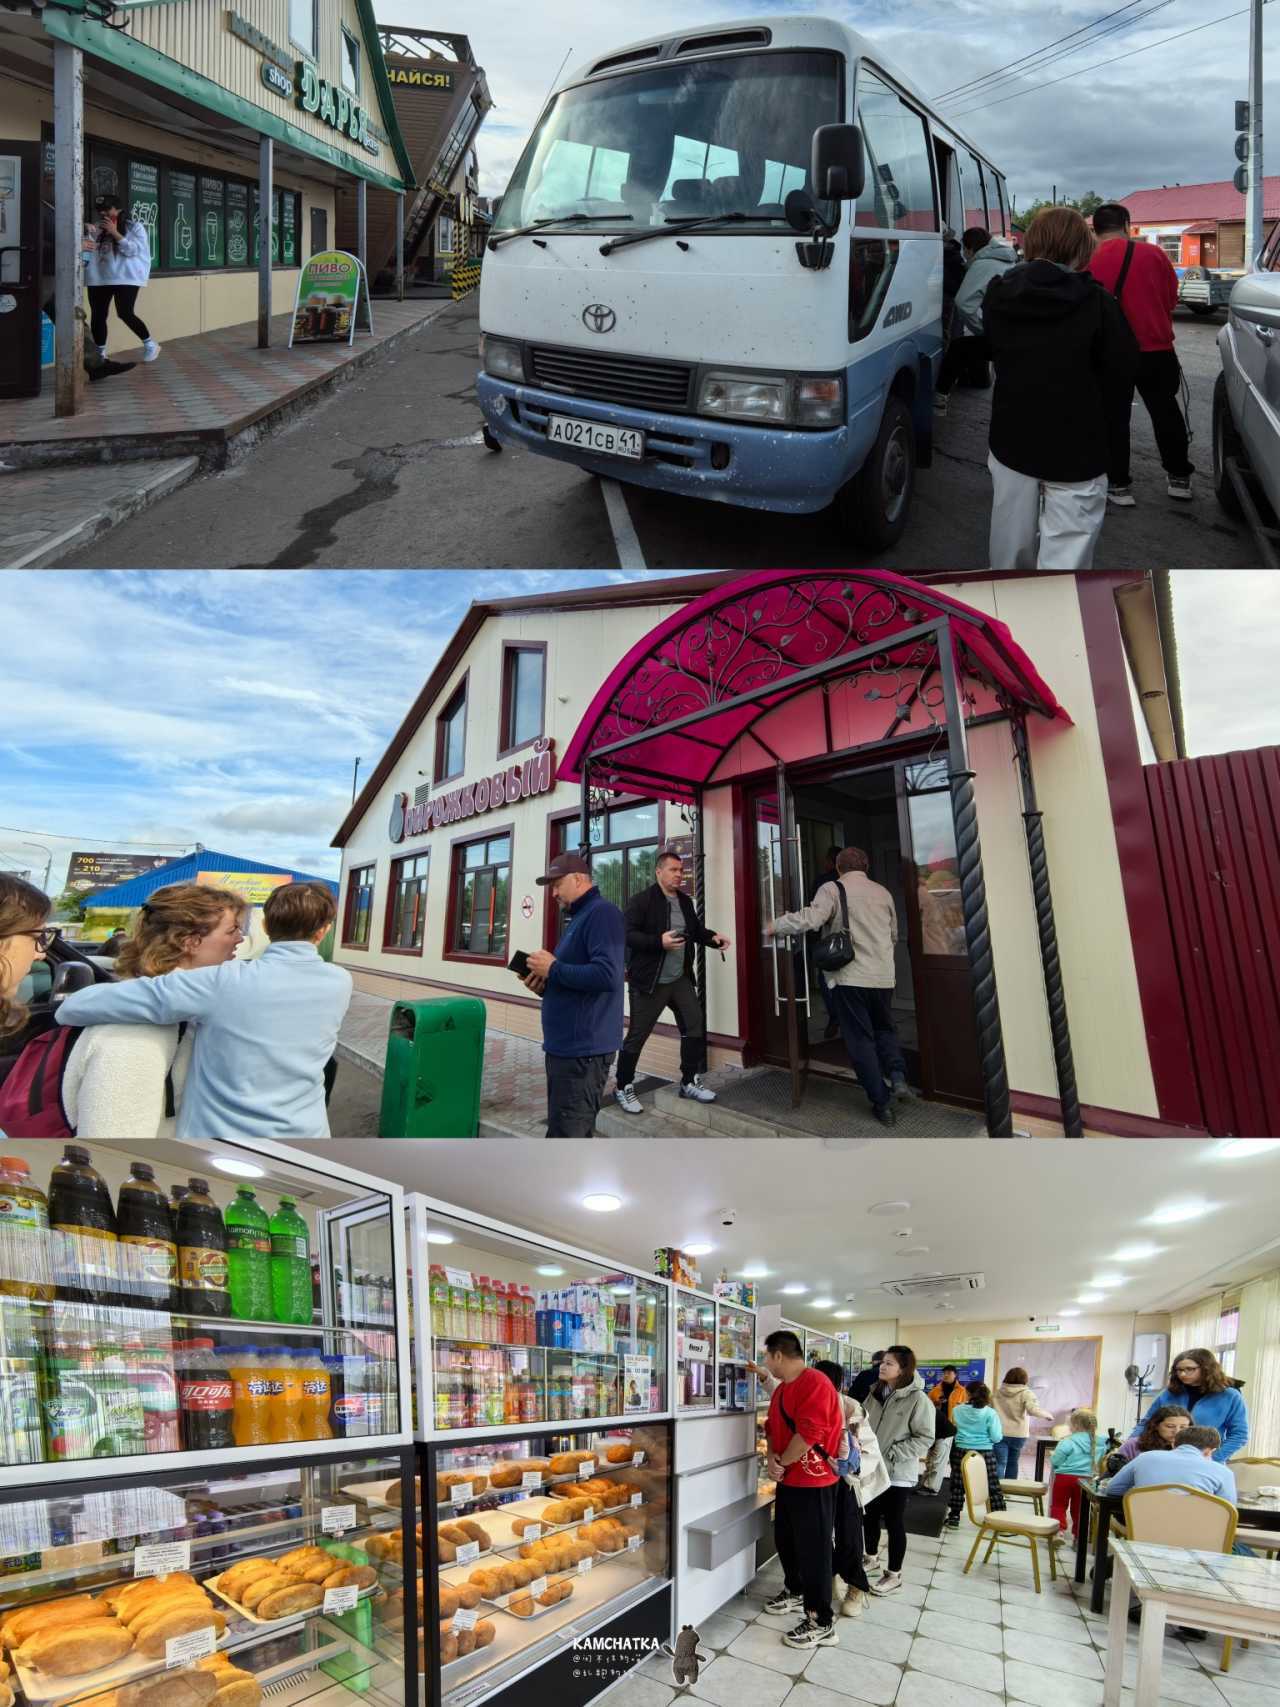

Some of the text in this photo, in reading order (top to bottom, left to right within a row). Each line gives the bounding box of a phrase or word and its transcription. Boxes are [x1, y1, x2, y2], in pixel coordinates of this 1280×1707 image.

[268, 67, 293, 96] shop
[301, 61, 368, 143] ДАРЬЯ
[308, 263, 351, 273] ПИВО
[554, 423, 637, 449] А021СВ 41
[403, 737, 551, 837] ПИРОЖКОВЫЙ
[77, 856, 95, 864] 700
